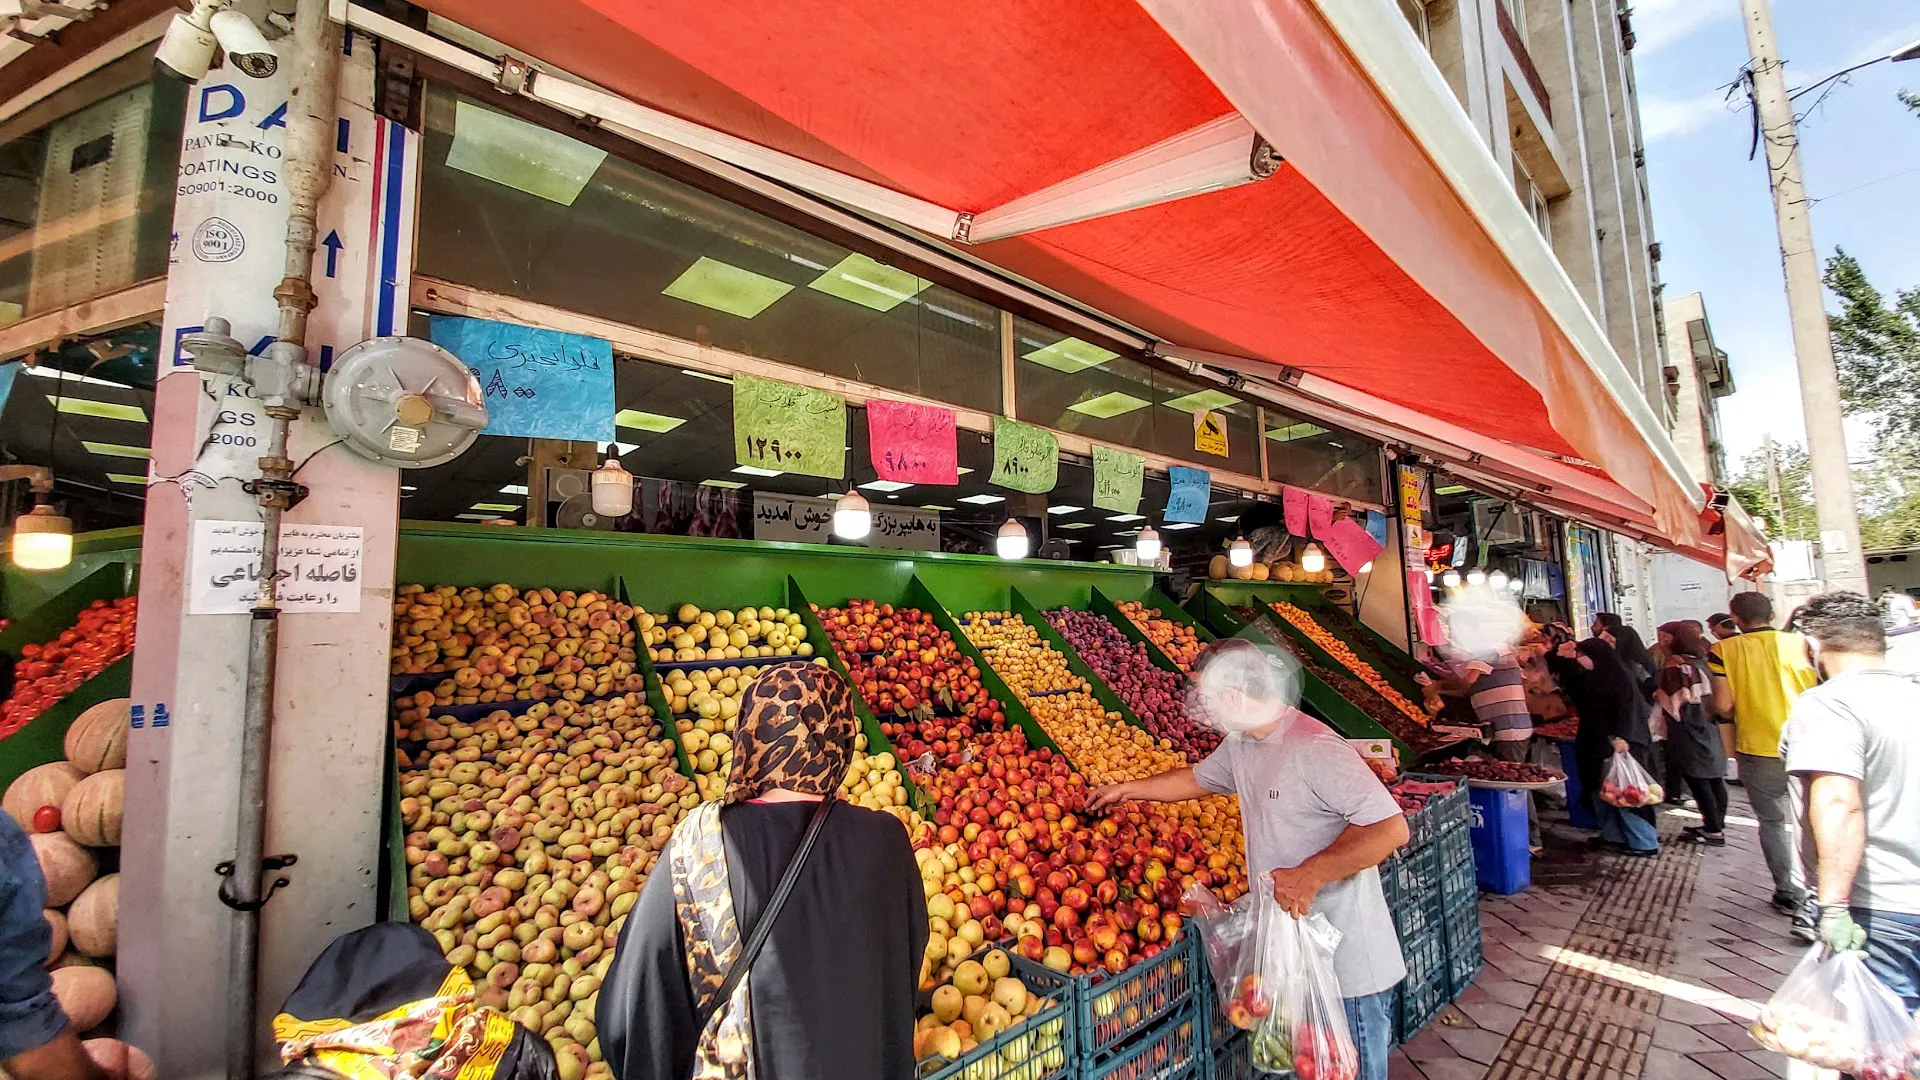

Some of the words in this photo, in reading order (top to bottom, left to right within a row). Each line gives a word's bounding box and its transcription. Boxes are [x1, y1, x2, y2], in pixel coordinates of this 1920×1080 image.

[205, 230, 228, 240] ISO
[203, 240, 228, 250] 9001
[746, 435, 802, 463] ۱۲۹۰۰
[756, 500, 794, 525] آمدید
[794, 507, 832, 532] خوش
[896, 513, 925, 537] هایپر
[926, 519, 937, 536] به
[210, 546, 264, 557] واهشمندیم
[280, 547, 304, 558] عزیزا
[305, 563, 357, 582] فاصله
[285, 592, 324, 605] رعایت
[326, 592, 338, 604] را
